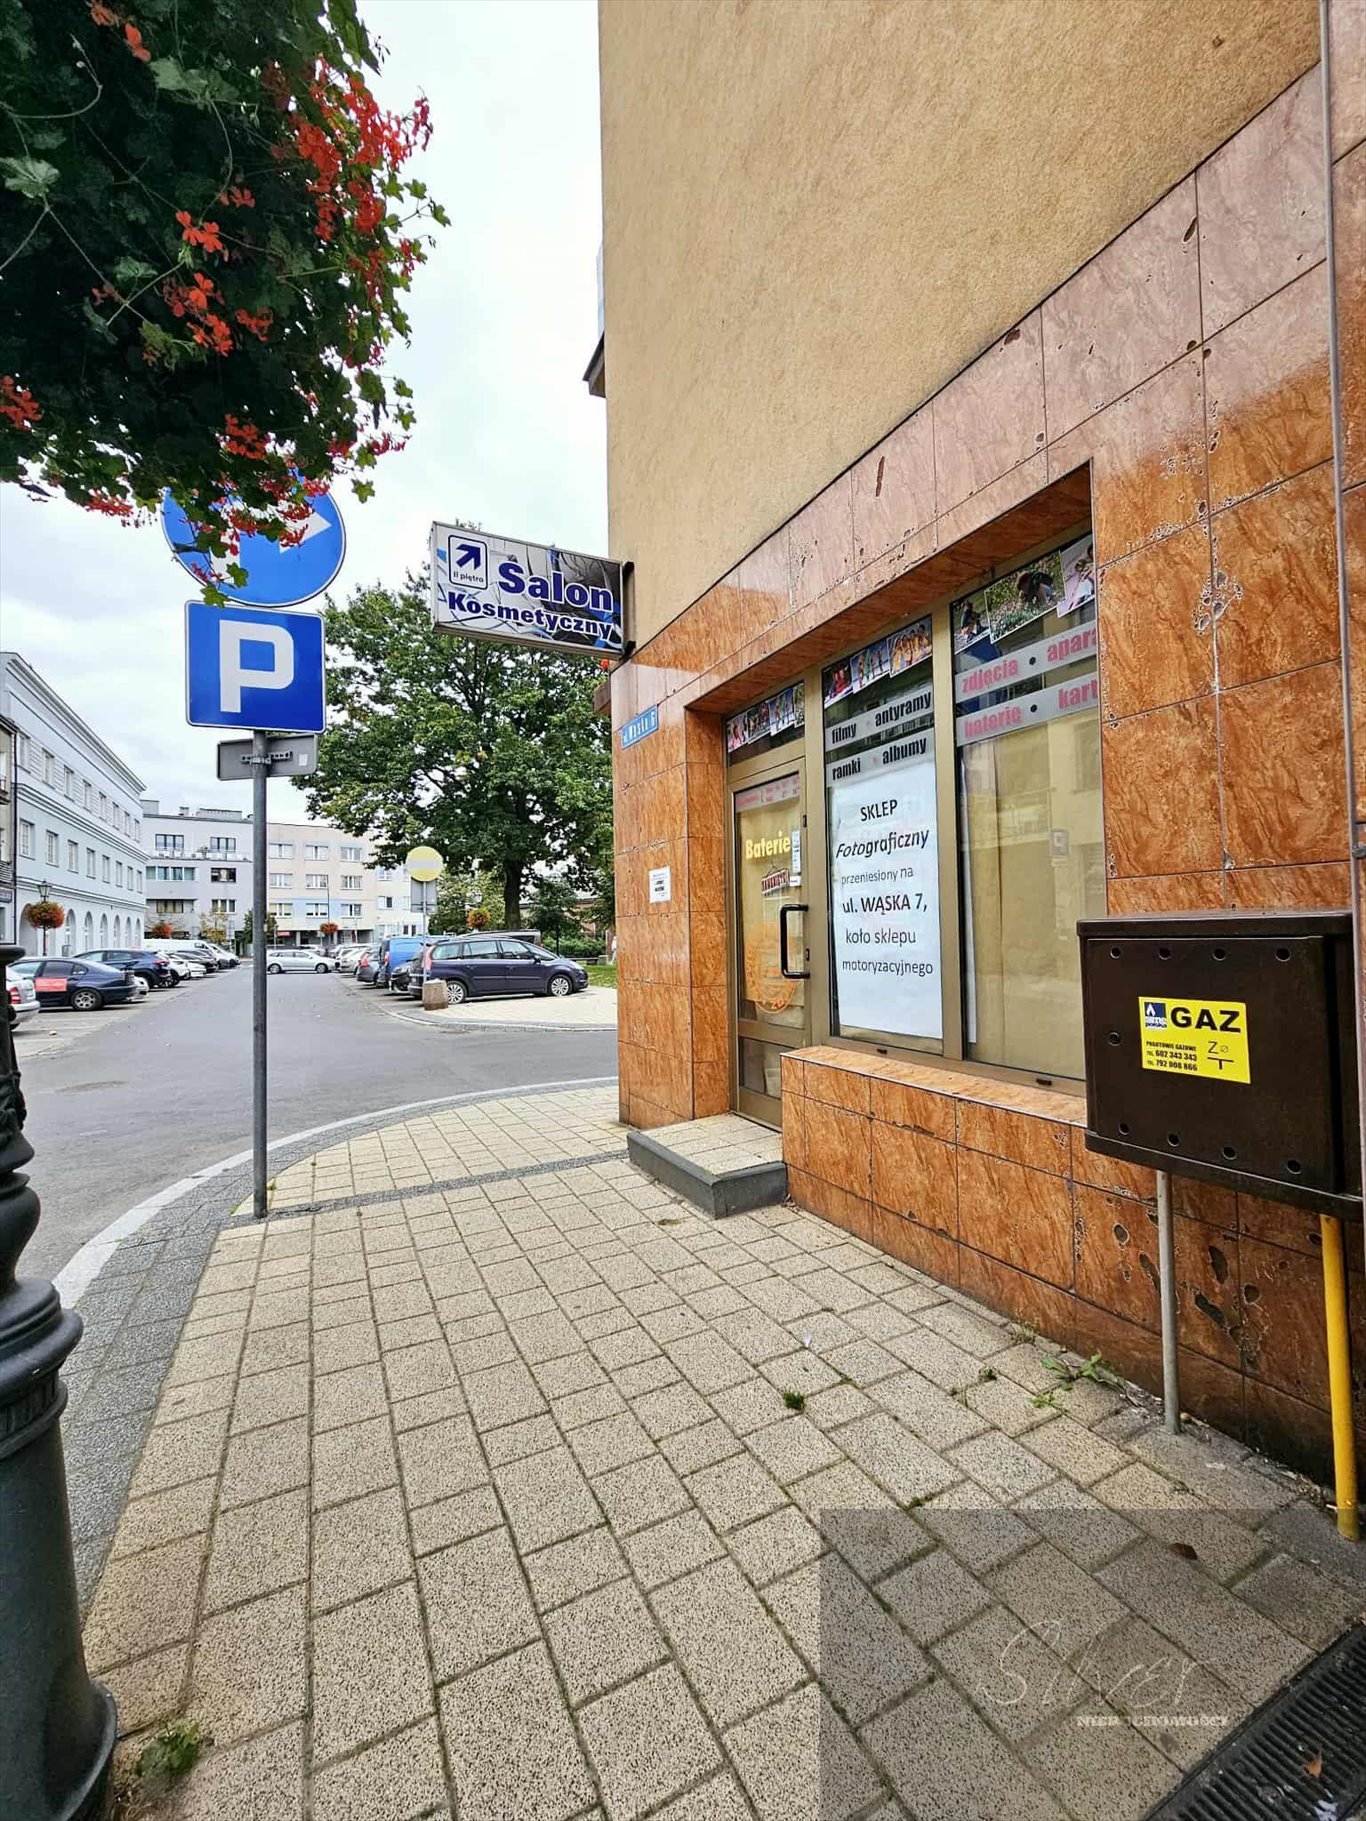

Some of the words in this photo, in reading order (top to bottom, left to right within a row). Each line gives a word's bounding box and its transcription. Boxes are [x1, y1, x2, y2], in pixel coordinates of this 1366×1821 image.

[499, 562, 613, 612] Salon
[449, 591, 612, 640] Kosmetyczny
[219, 619, 294, 713] P
[832, 723, 857, 745] filmy
[875, 692, 931, 727] antyramy
[964, 706, 1021, 738] baterie
[832, 758, 861, 780] ramki
[882, 738, 927, 765] albumy
[860, 799, 898, 822] SKLEP
[745, 830, 791, 860] Baterie
[836, 829, 929, 859] Fotograficzny
[841, 869, 898, 888] przeniesiony
[900, 867, 914, 878] na
[842, 899, 858, 914] ul.
[861, 894, 911, 916] WĄSKA
[915, 893, 927, 913] 7,
[846, 928, 871, 945] koło
[874, 928, 916, 947] sklepu
[842, 959, 934, 978] motoryzacyjnego
[1171, 1007, 1241, 1033] GAZ
